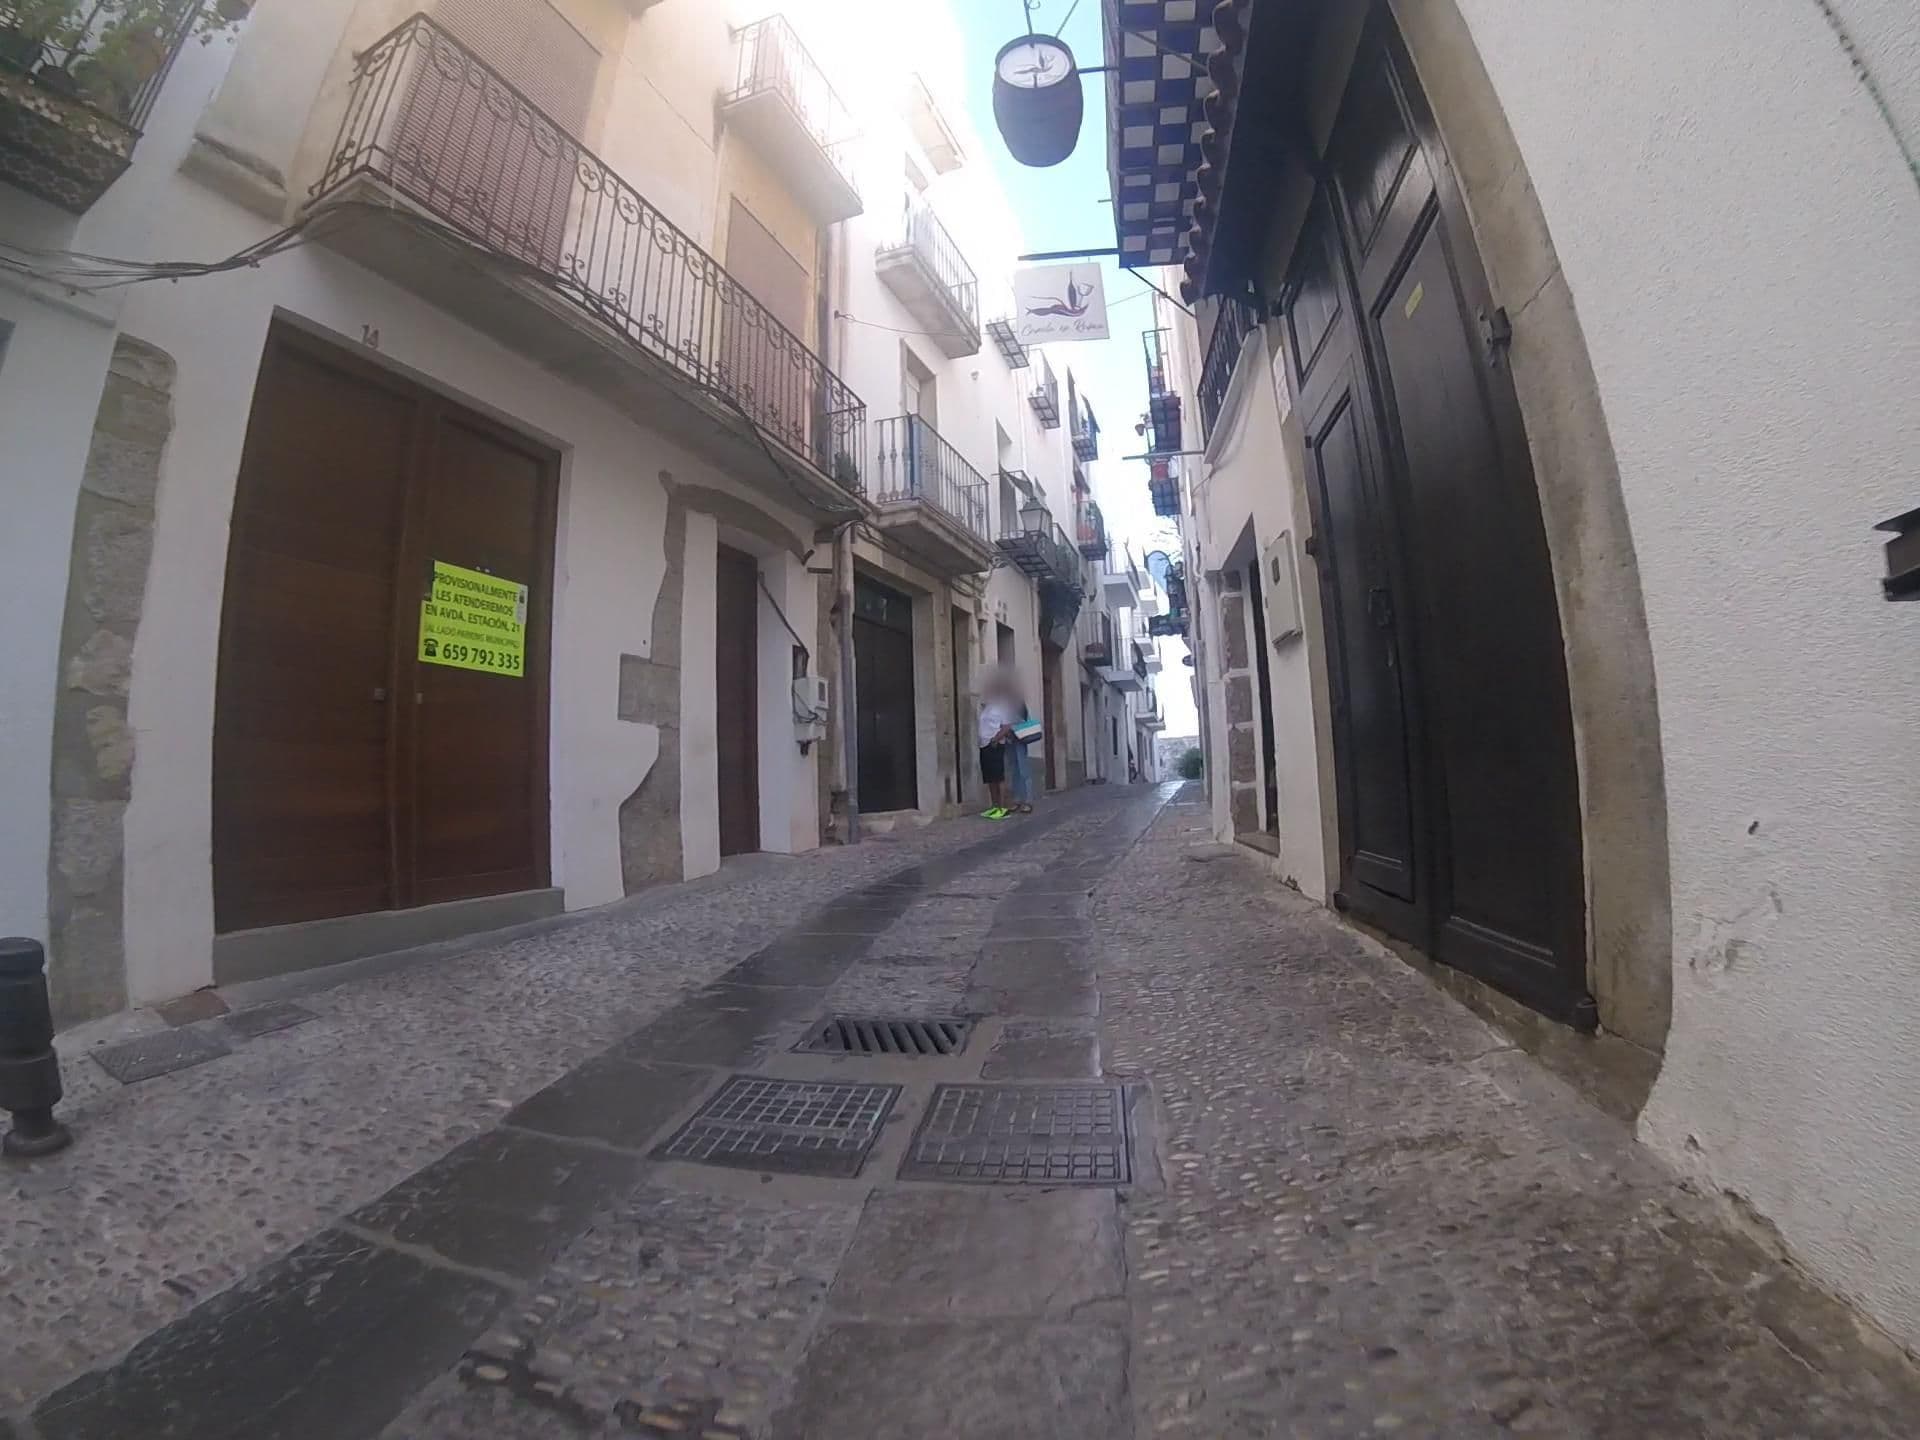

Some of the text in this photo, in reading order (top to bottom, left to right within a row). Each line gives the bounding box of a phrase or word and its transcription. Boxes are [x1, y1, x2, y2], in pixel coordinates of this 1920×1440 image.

[434, 571, 518, 602] PROVISIONALMENTE
[425, 604, 438, 616] EN
[435, 589, 514, 617] LES ATENDEREMOS
[442, 643, 520, 670] 659 792 335
